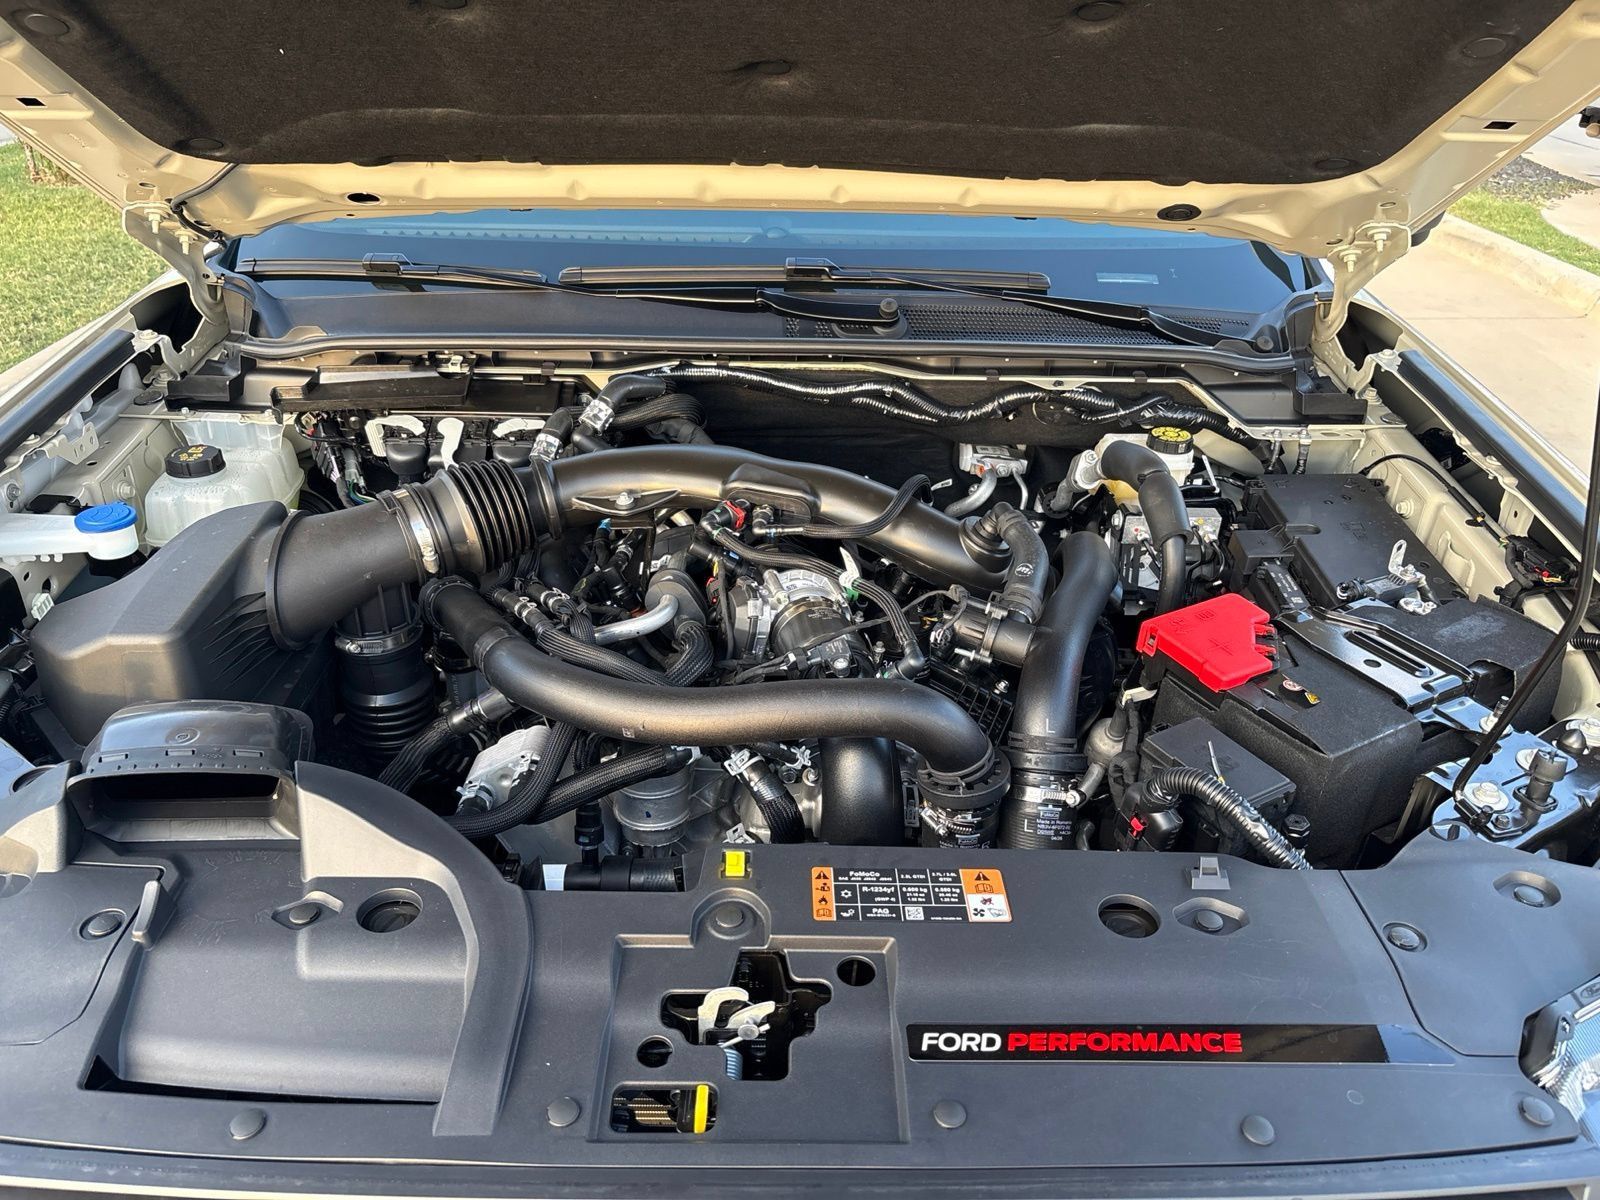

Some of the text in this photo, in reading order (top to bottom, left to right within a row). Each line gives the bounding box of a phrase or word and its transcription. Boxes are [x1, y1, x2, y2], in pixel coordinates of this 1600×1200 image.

[1046, 718, 1056, 733] L
[1024, 819, 1034, 832] L
[862, 886, 895, 894] R-1234yf
[919, 886, 928, 894] kg
[921, 1032, 1243, 1053] FORD PERFORMANCE
